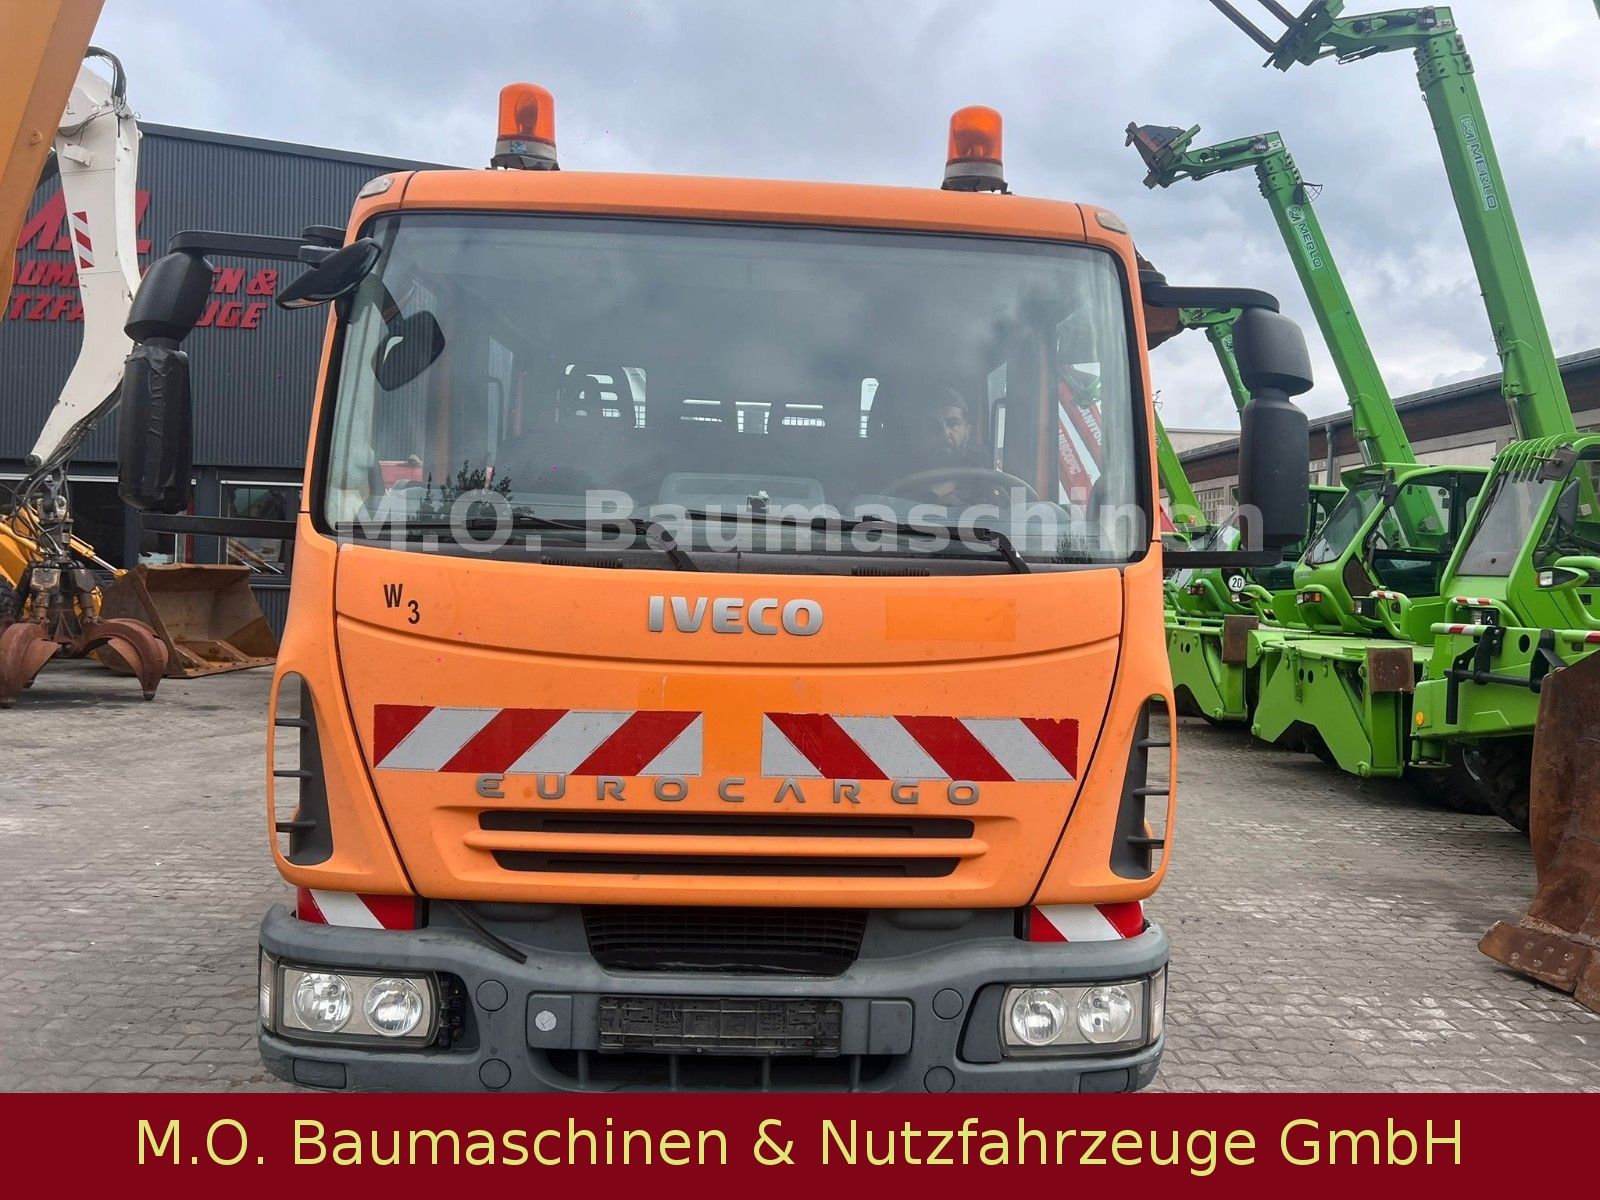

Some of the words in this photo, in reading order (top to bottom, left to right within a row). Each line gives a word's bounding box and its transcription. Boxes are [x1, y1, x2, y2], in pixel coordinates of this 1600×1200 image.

[383, 583, 404, 608] W
[1231, 577, 1243, 589] 20
[407, 600, 420, 625] 3
[648, 595, 823, 636] IVECO
[475, 773, 980, 804] EUROCARGO
